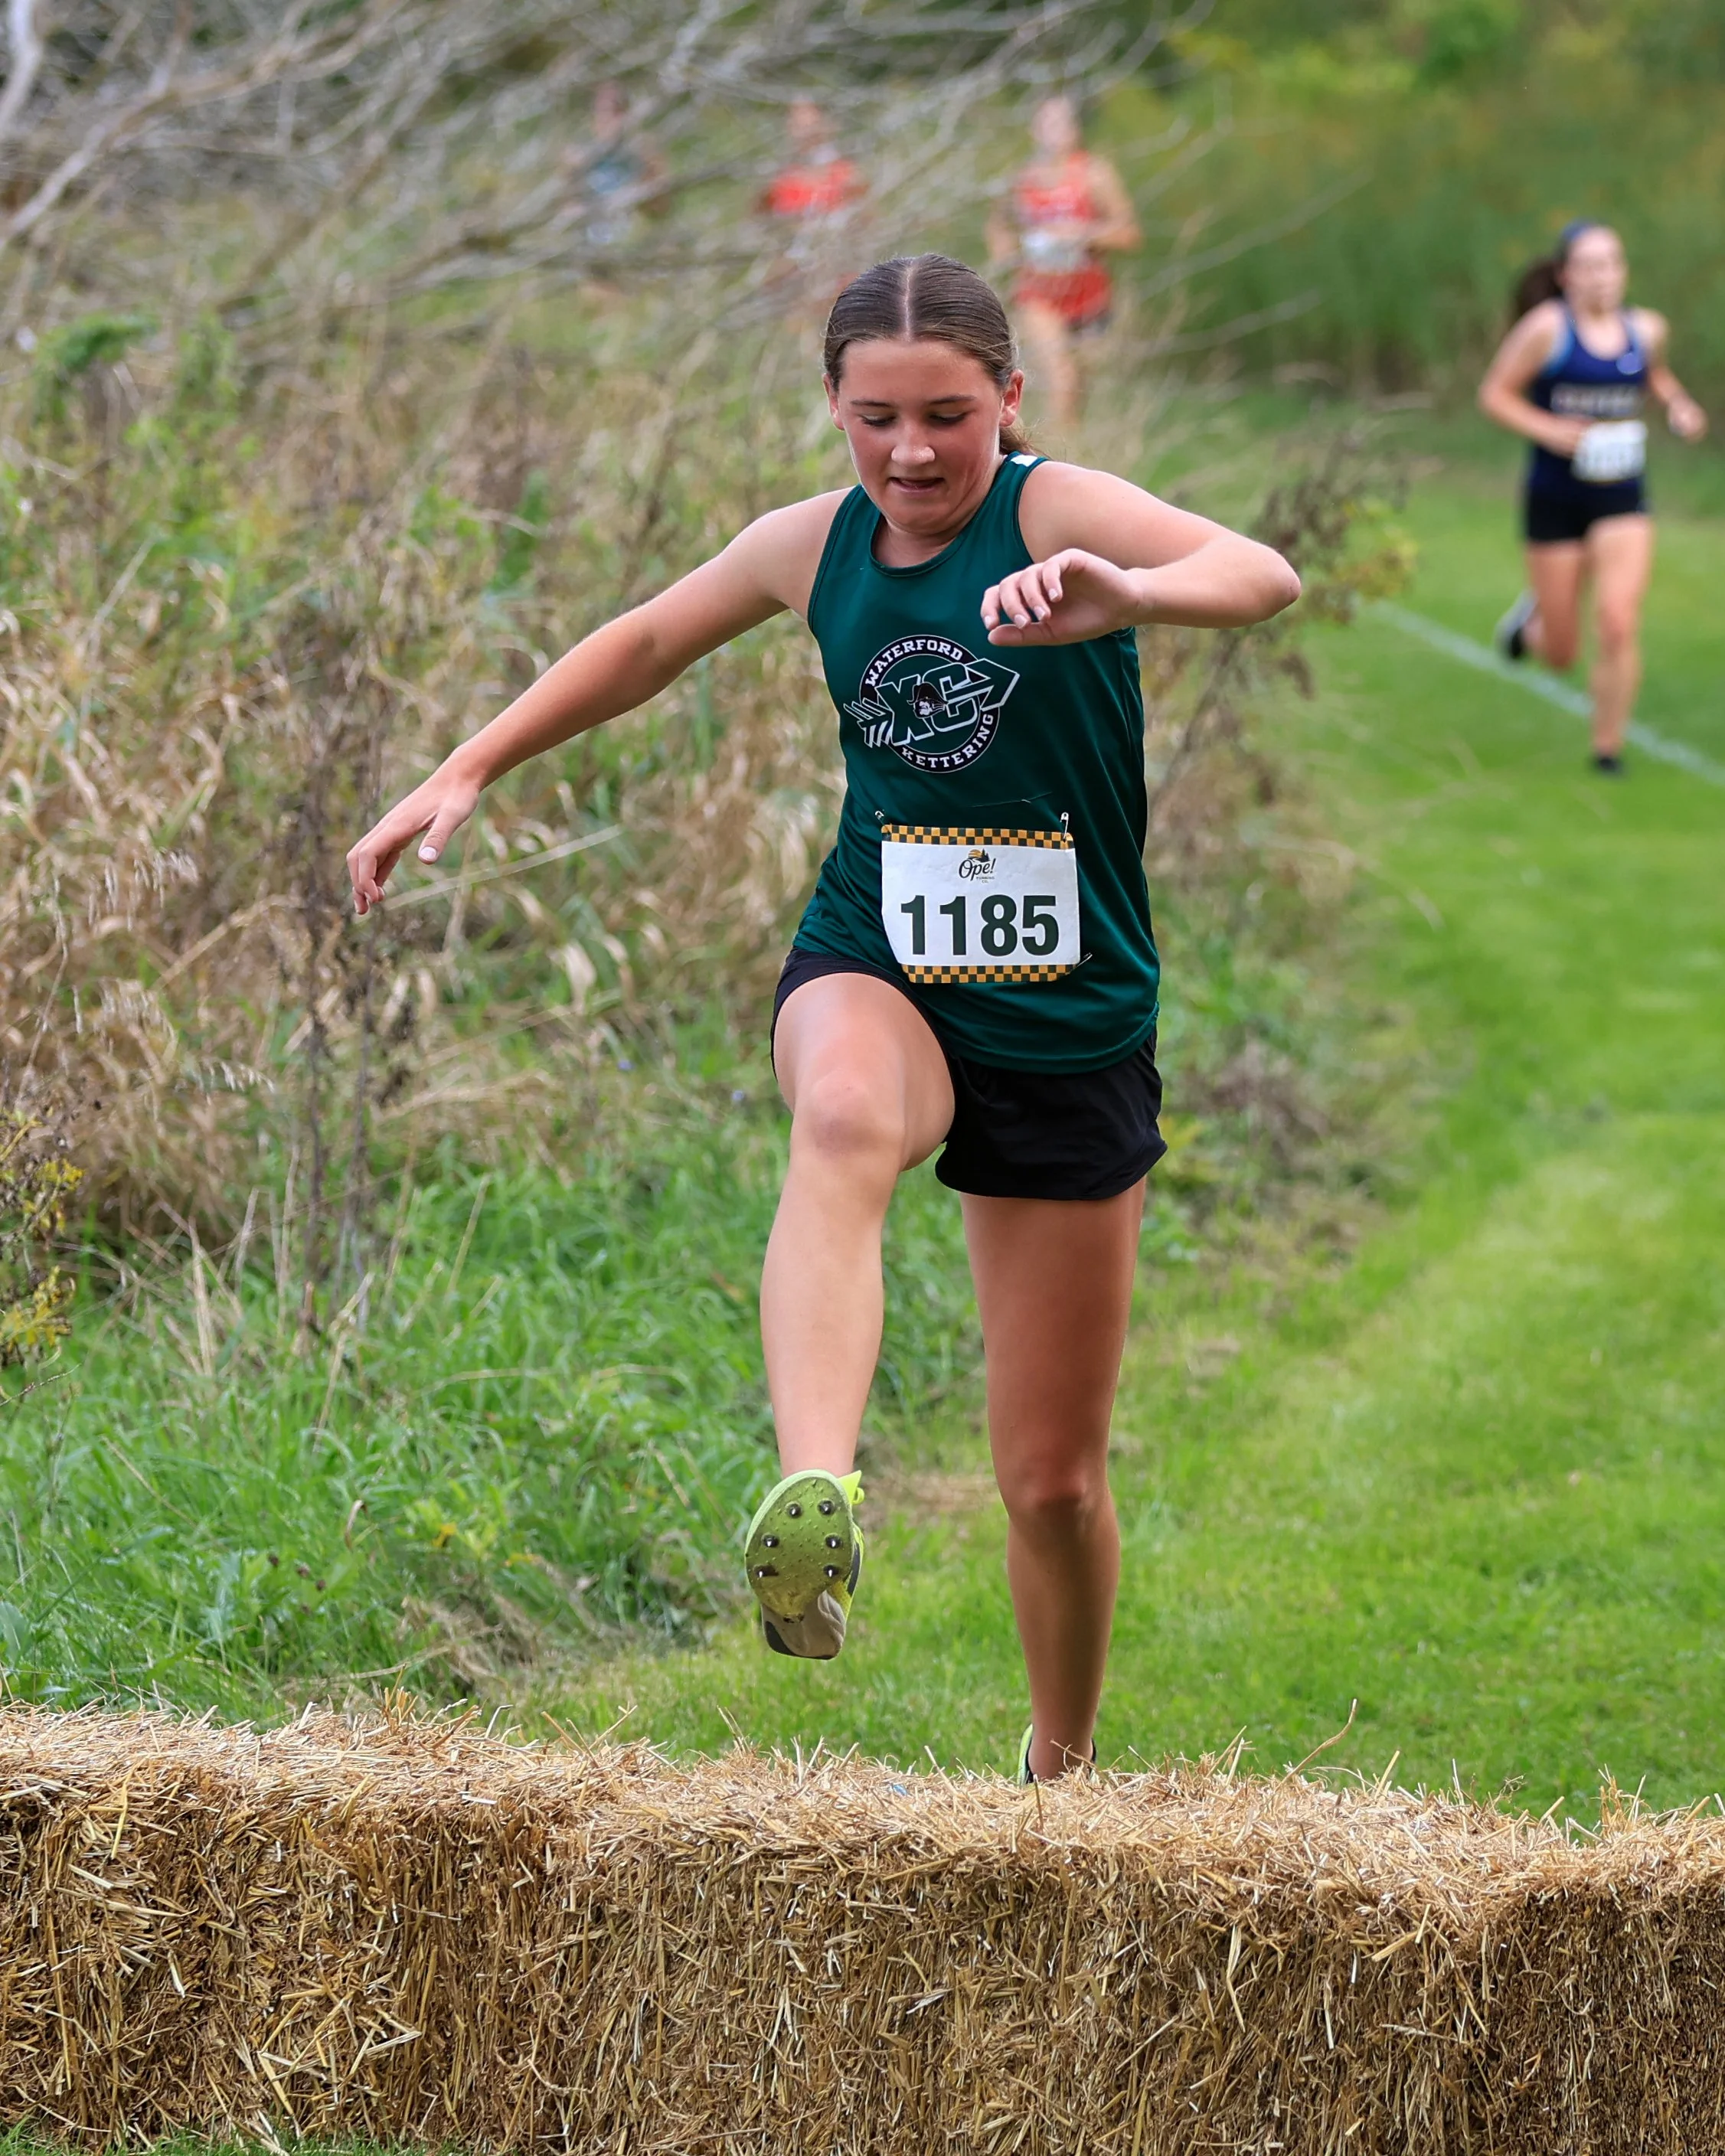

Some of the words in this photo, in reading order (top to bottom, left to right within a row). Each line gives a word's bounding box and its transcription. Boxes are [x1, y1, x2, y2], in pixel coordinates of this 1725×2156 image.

[865, 639, 963, 687] WATERFORD
[901, 713, 995, 769] KETTERING
[959, 858, 996, 881] Ope!
[900, 894, 1060, 957] 1185
